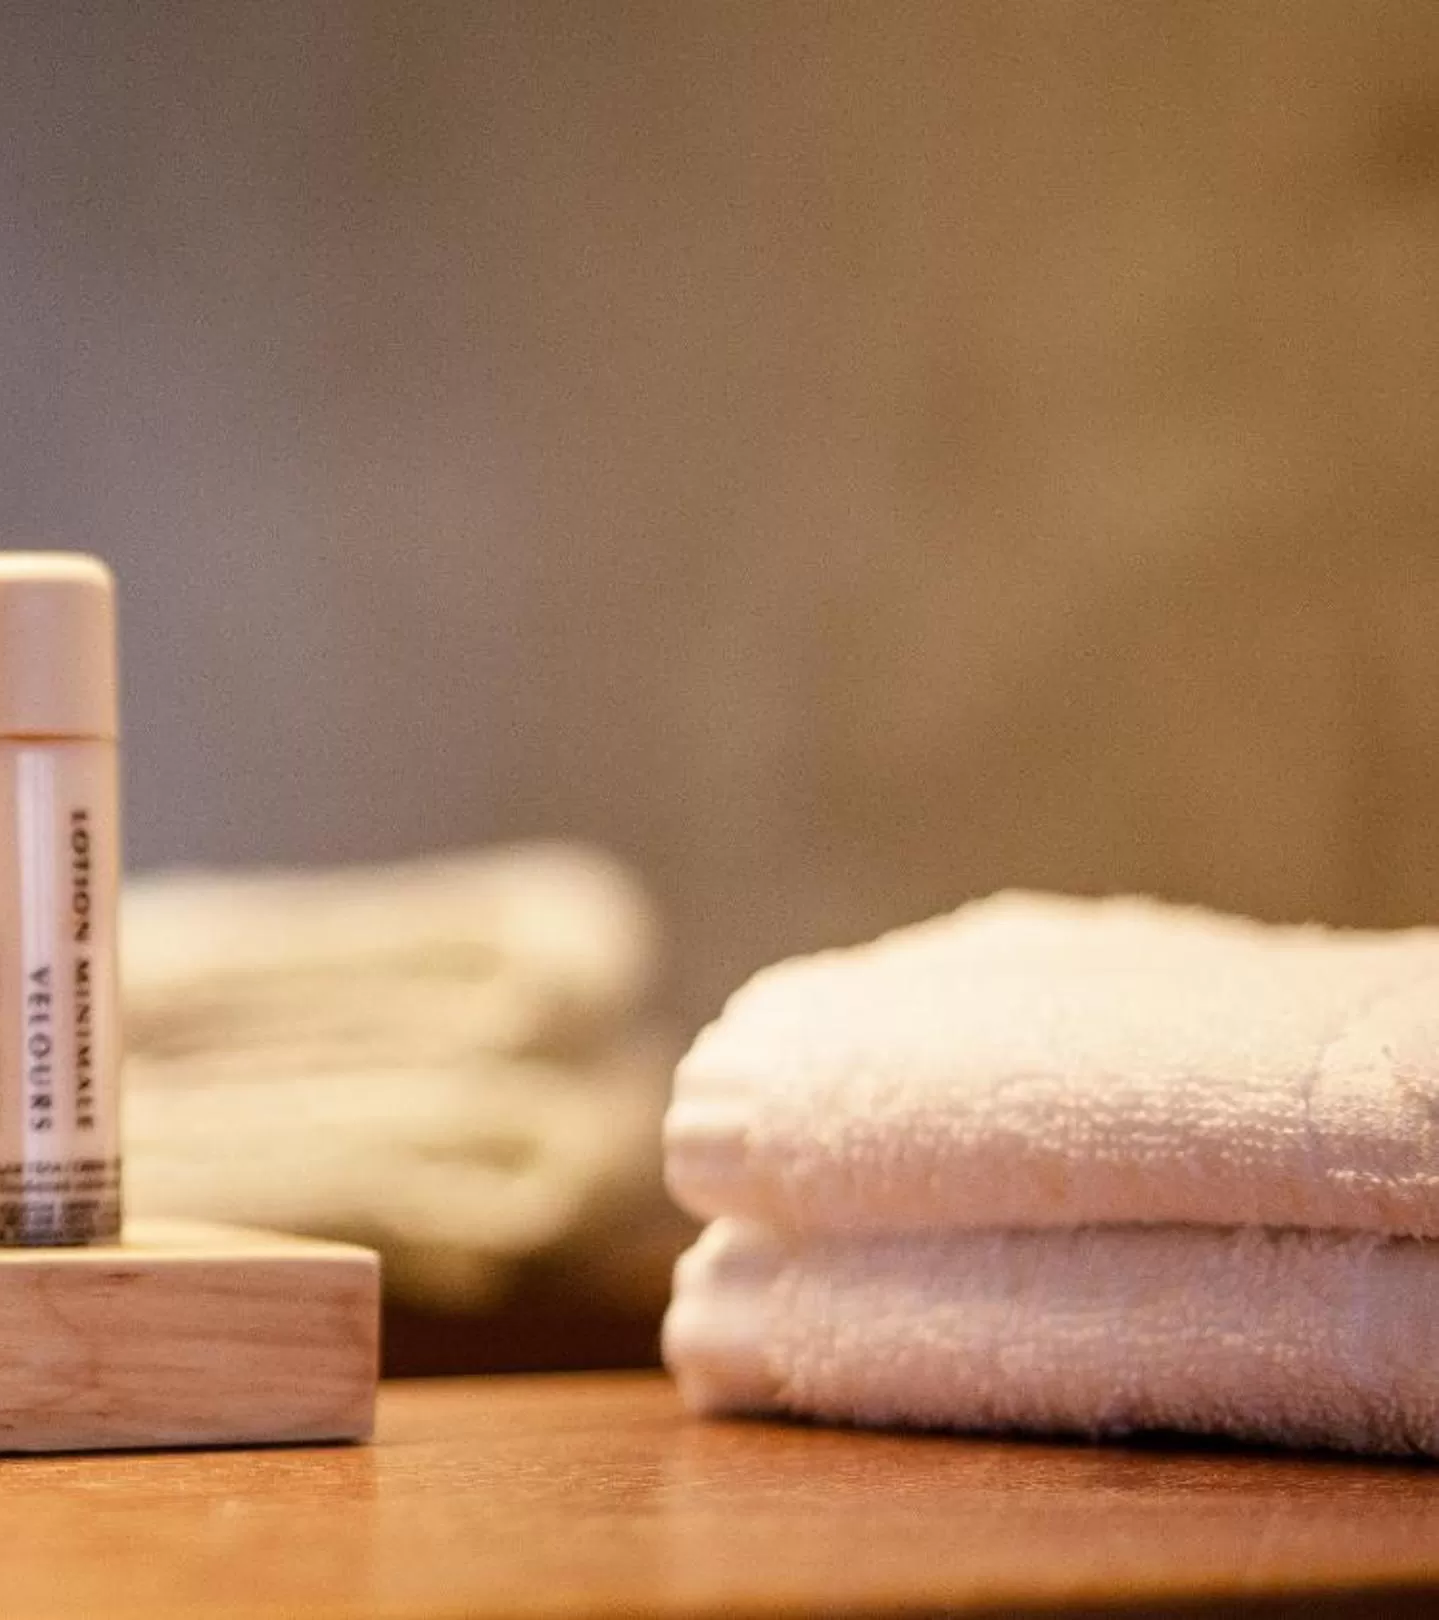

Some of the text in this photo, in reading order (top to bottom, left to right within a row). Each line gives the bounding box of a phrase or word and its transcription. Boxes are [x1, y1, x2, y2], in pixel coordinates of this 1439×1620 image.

[29, 966, 53, 1132] VELOURS
[70, 810, 95, 1131] LOTION MINIMALE
